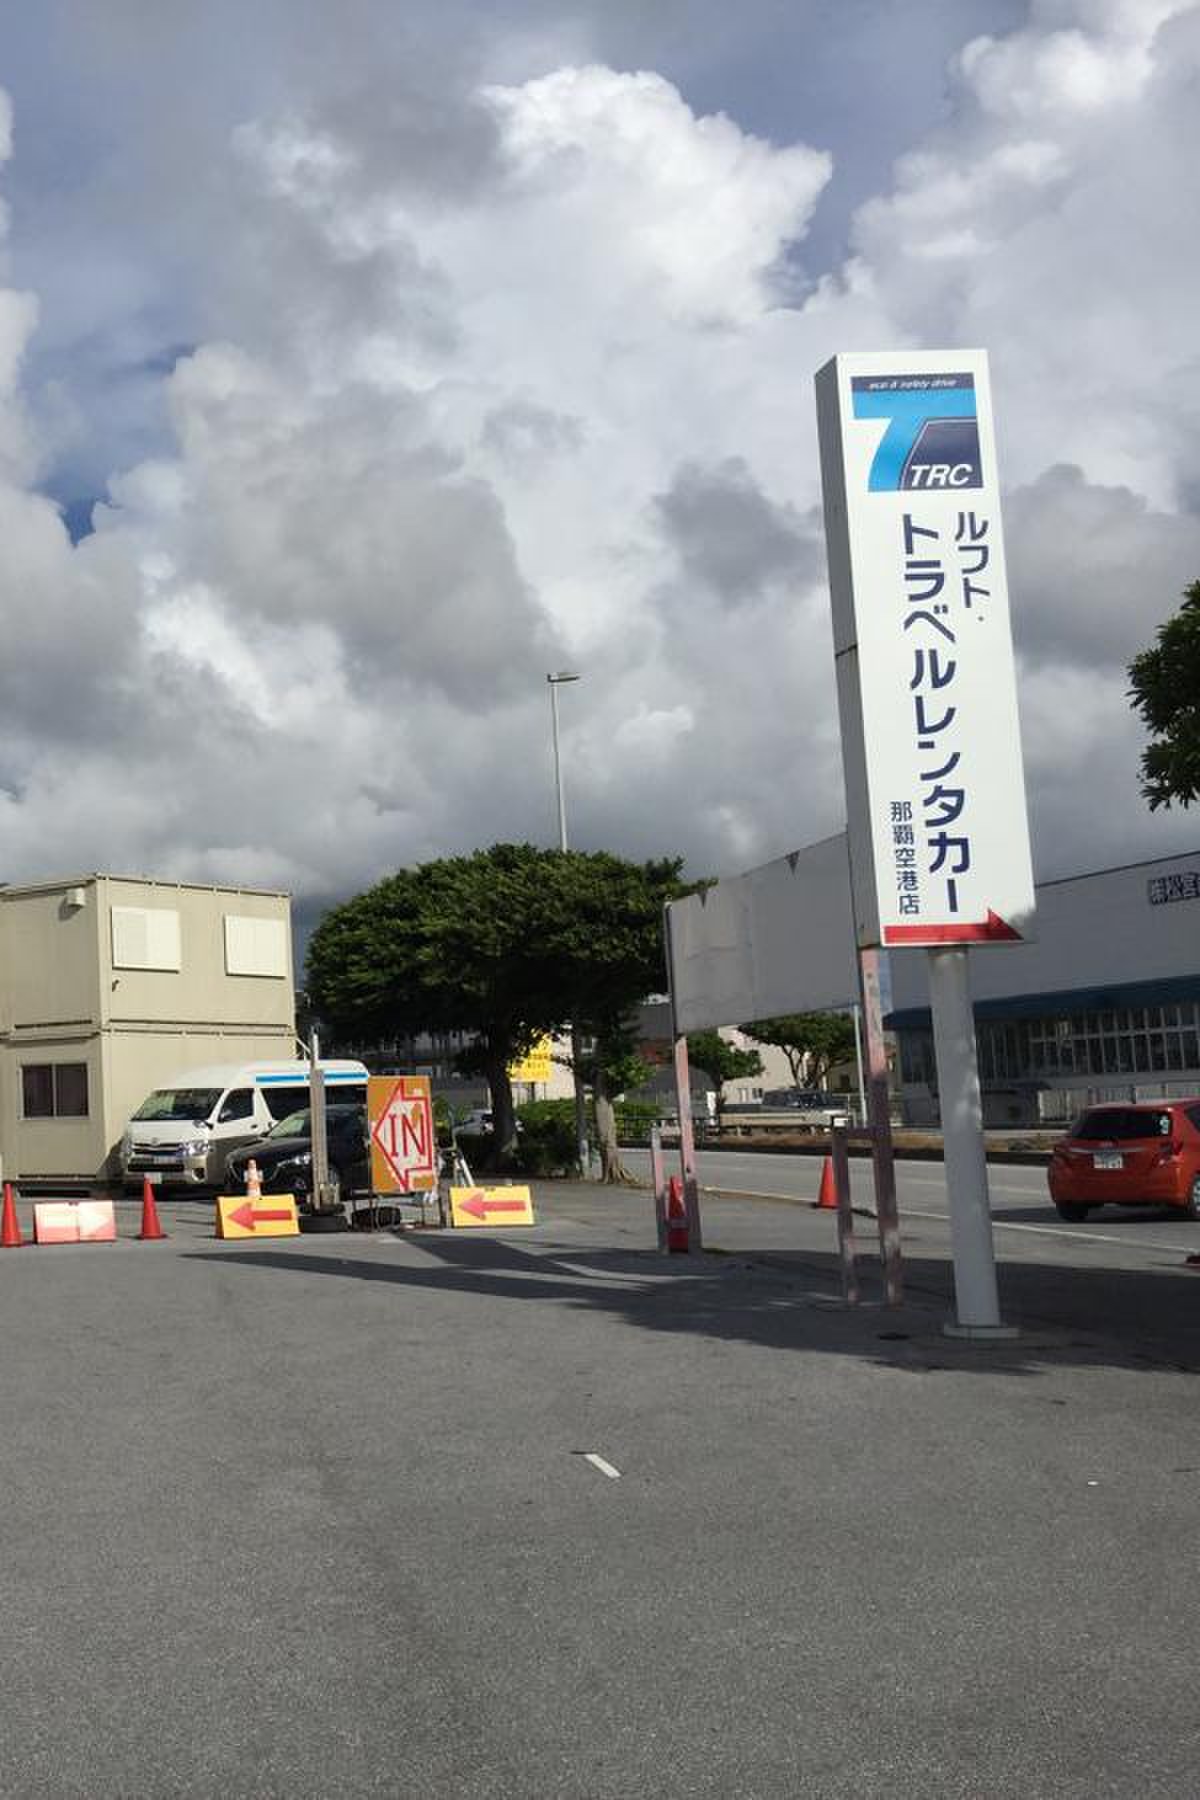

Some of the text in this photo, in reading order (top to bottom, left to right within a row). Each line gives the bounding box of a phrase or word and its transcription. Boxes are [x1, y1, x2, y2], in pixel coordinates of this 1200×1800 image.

[910, 464, 973, 486] TRC
[903, 513, 971, 913] トラベルレンタカー
[890, 801, 920, 915] 那覇空港店
[389, 1114, 426, 1157] IN
